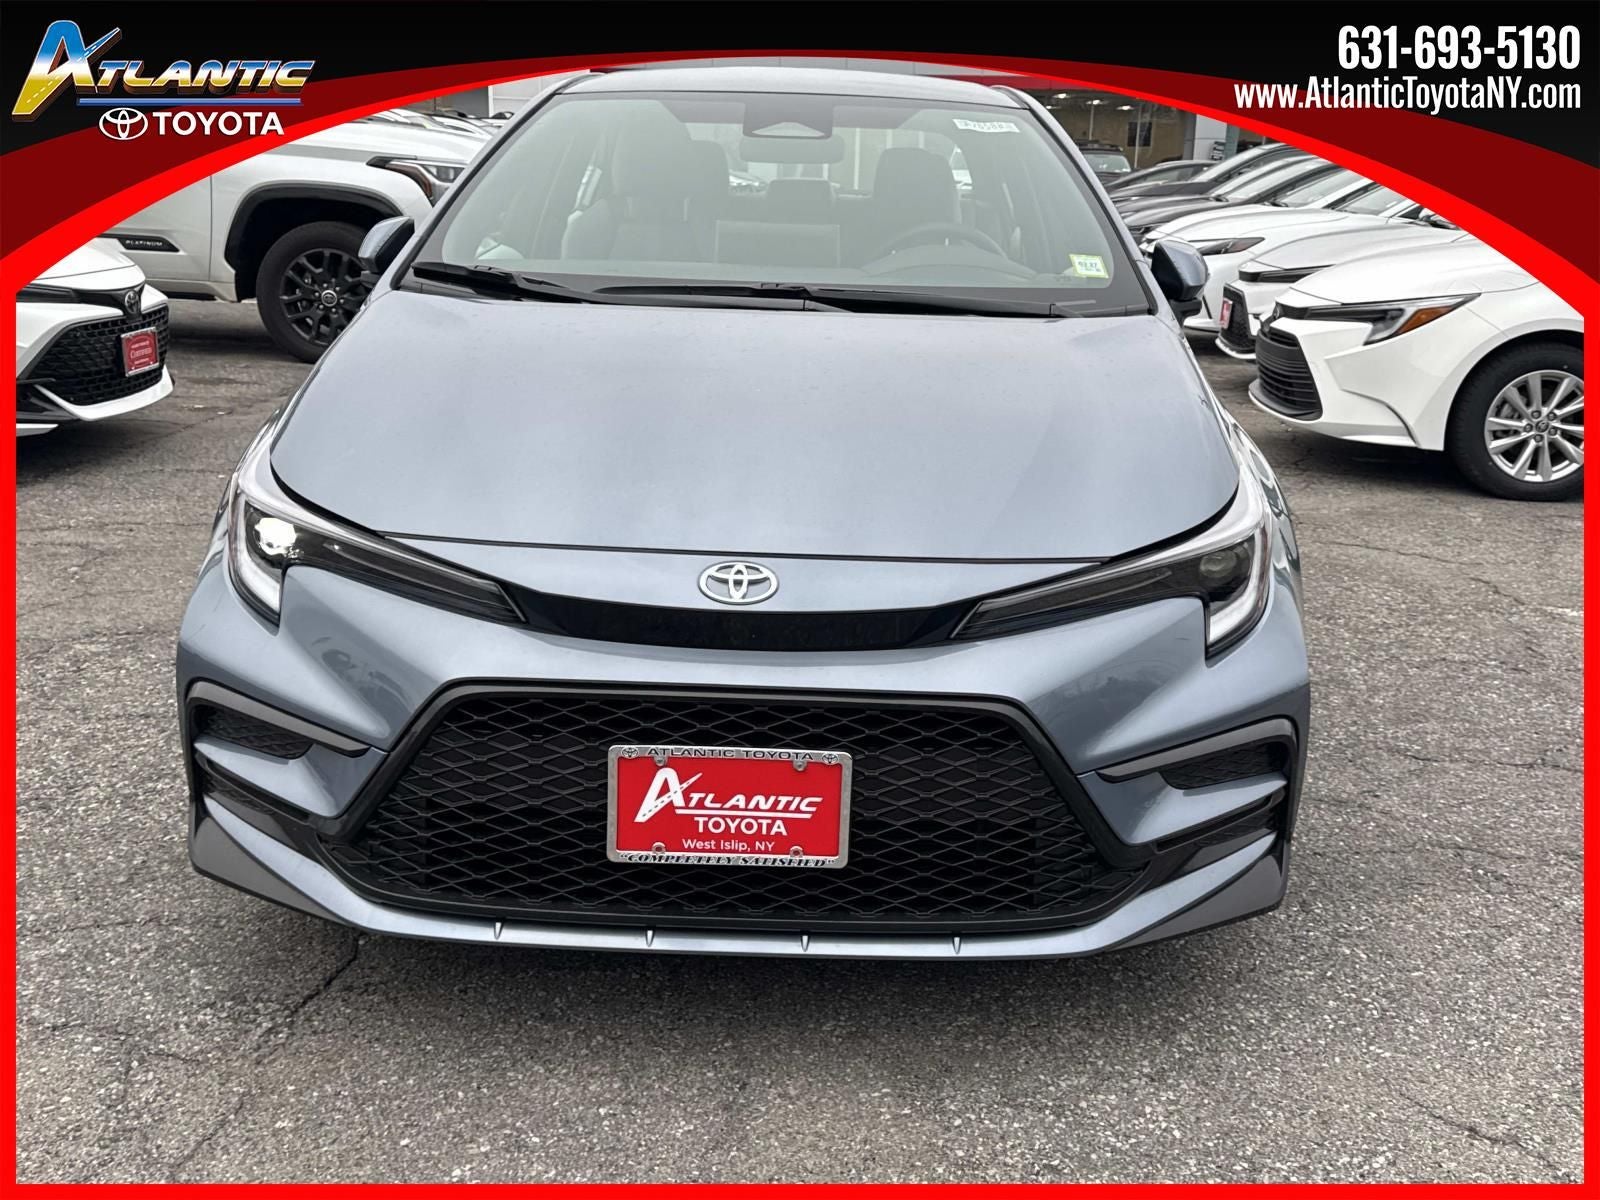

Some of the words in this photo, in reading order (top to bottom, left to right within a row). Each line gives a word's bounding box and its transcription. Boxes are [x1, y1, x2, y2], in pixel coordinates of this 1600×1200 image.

[647, 748, 735, 758] ATLANTIC
[742, 751, 814, 761] TOYOTA
[634, 767, 823, 822] ATLANTIC
[694, 816, 788, 836] TOYOTA
[682, 839, 716, 850] West
[720, 839, 750, 852] Islip,
[755, 841, 775, 852] NY
